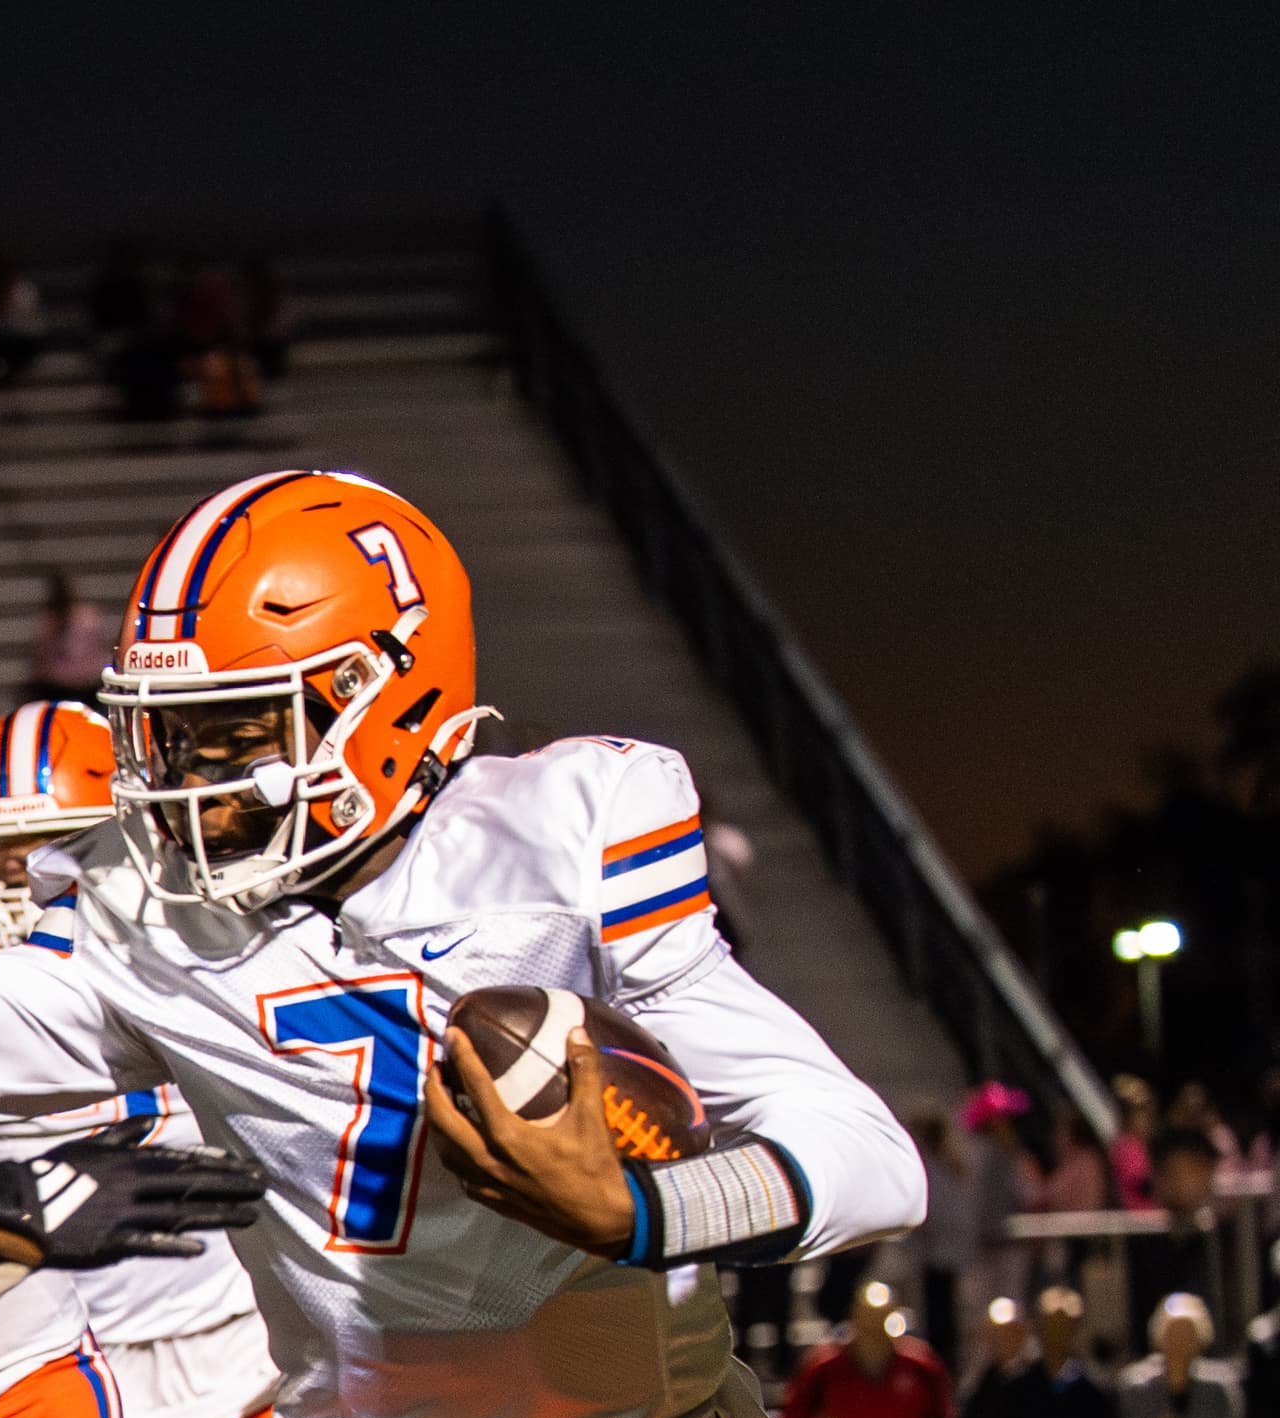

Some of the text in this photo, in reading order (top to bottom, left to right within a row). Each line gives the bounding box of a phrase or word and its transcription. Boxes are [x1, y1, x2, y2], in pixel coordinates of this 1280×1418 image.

[346, 520, 426, 614] 7
[129, 649, 188, 669] Riddell
[256, 971, 436, 1256] 7
